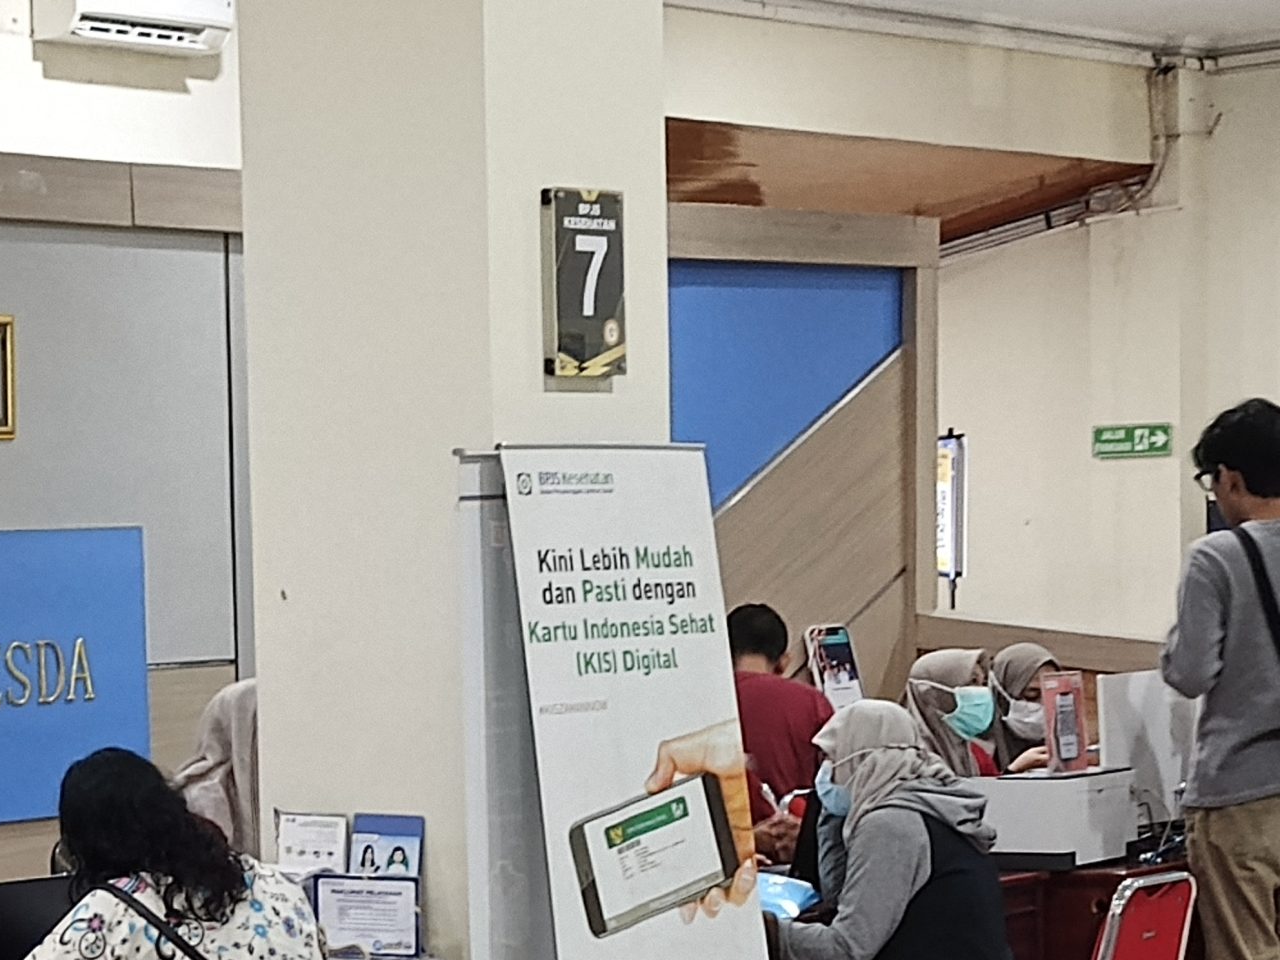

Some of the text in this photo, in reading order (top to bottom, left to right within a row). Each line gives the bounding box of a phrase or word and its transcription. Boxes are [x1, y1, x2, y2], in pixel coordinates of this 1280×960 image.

[576, 234, 608, 316] 7
[538, 545, 693, 572] Kini Lebih Mudah
[542, 578, 696, 605] dan Pasti dengan
[528, 613, 715, 643] Kartu Indonesia Sehat
[576, 648, 678, 676] (KIS) Digital
